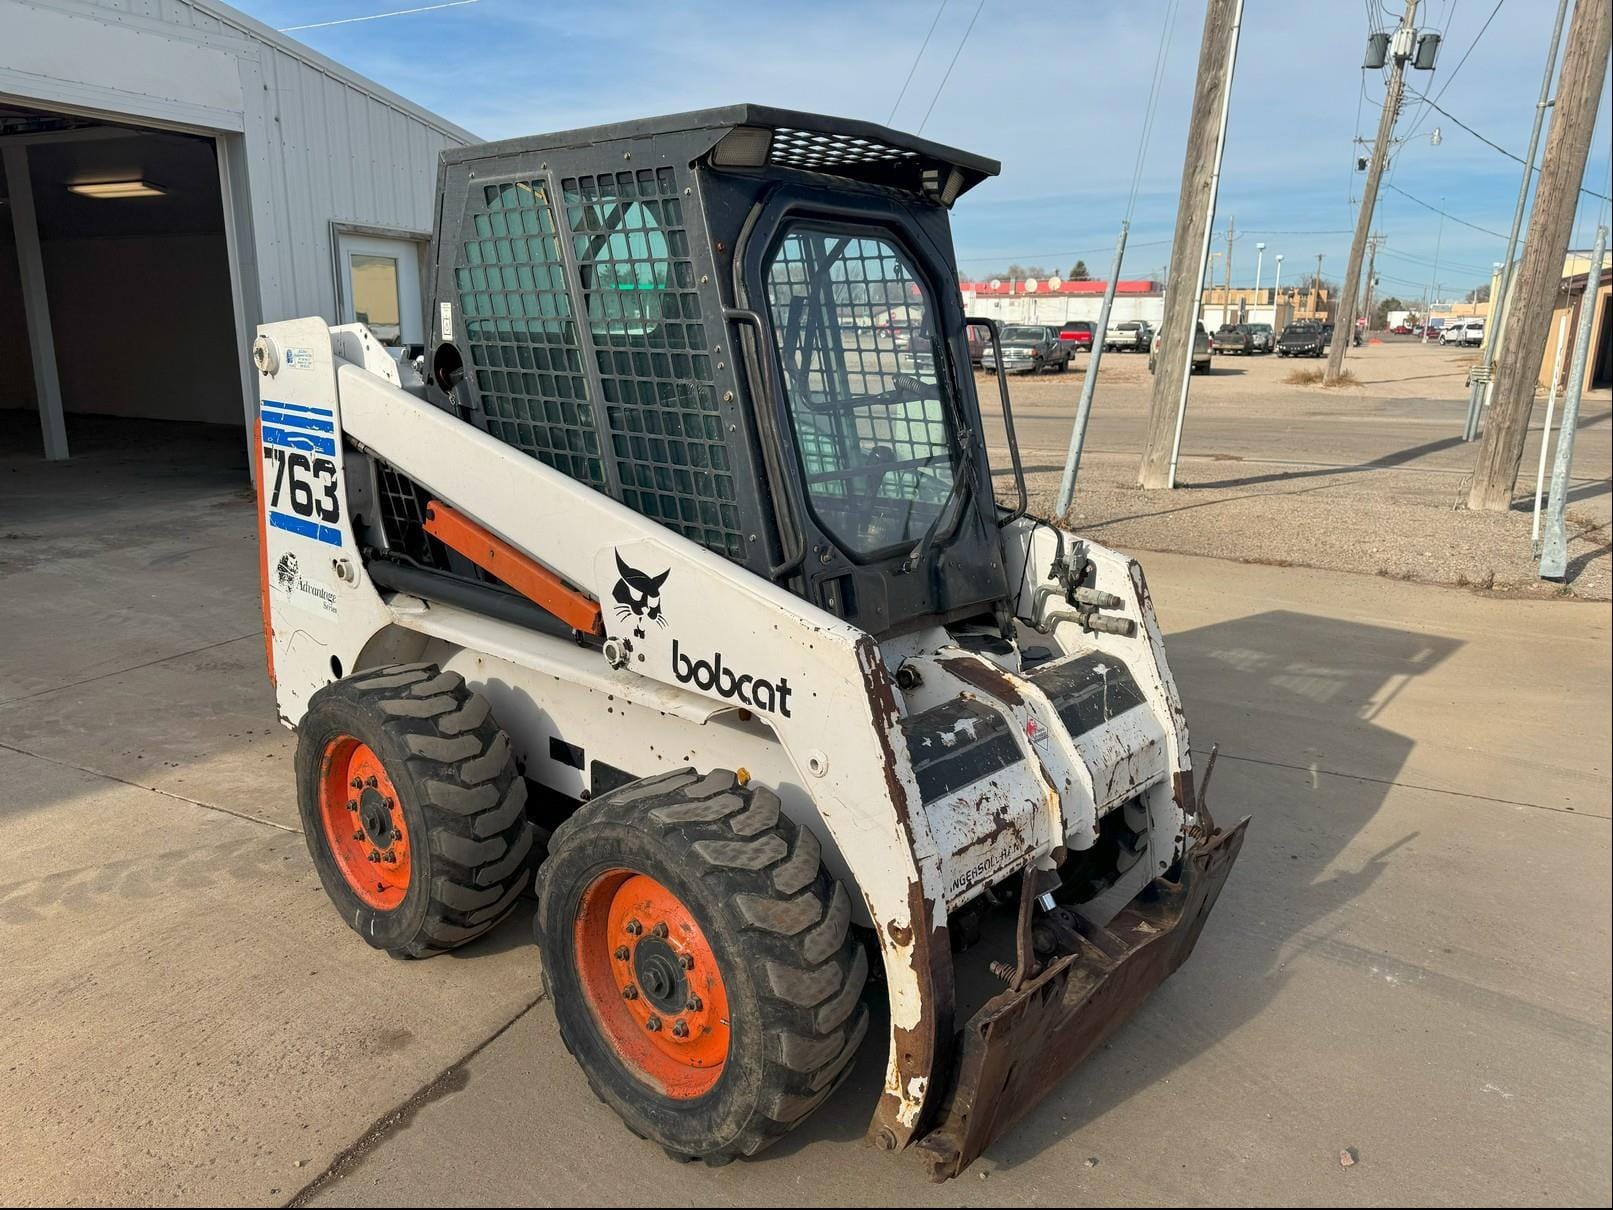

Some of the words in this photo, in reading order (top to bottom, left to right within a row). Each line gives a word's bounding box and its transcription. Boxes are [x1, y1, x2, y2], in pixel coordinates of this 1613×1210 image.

[264, 447, 339, 524] 763
[296, 578, 337, 604] Advantage
[672, 639, 792, 718] bobcat
